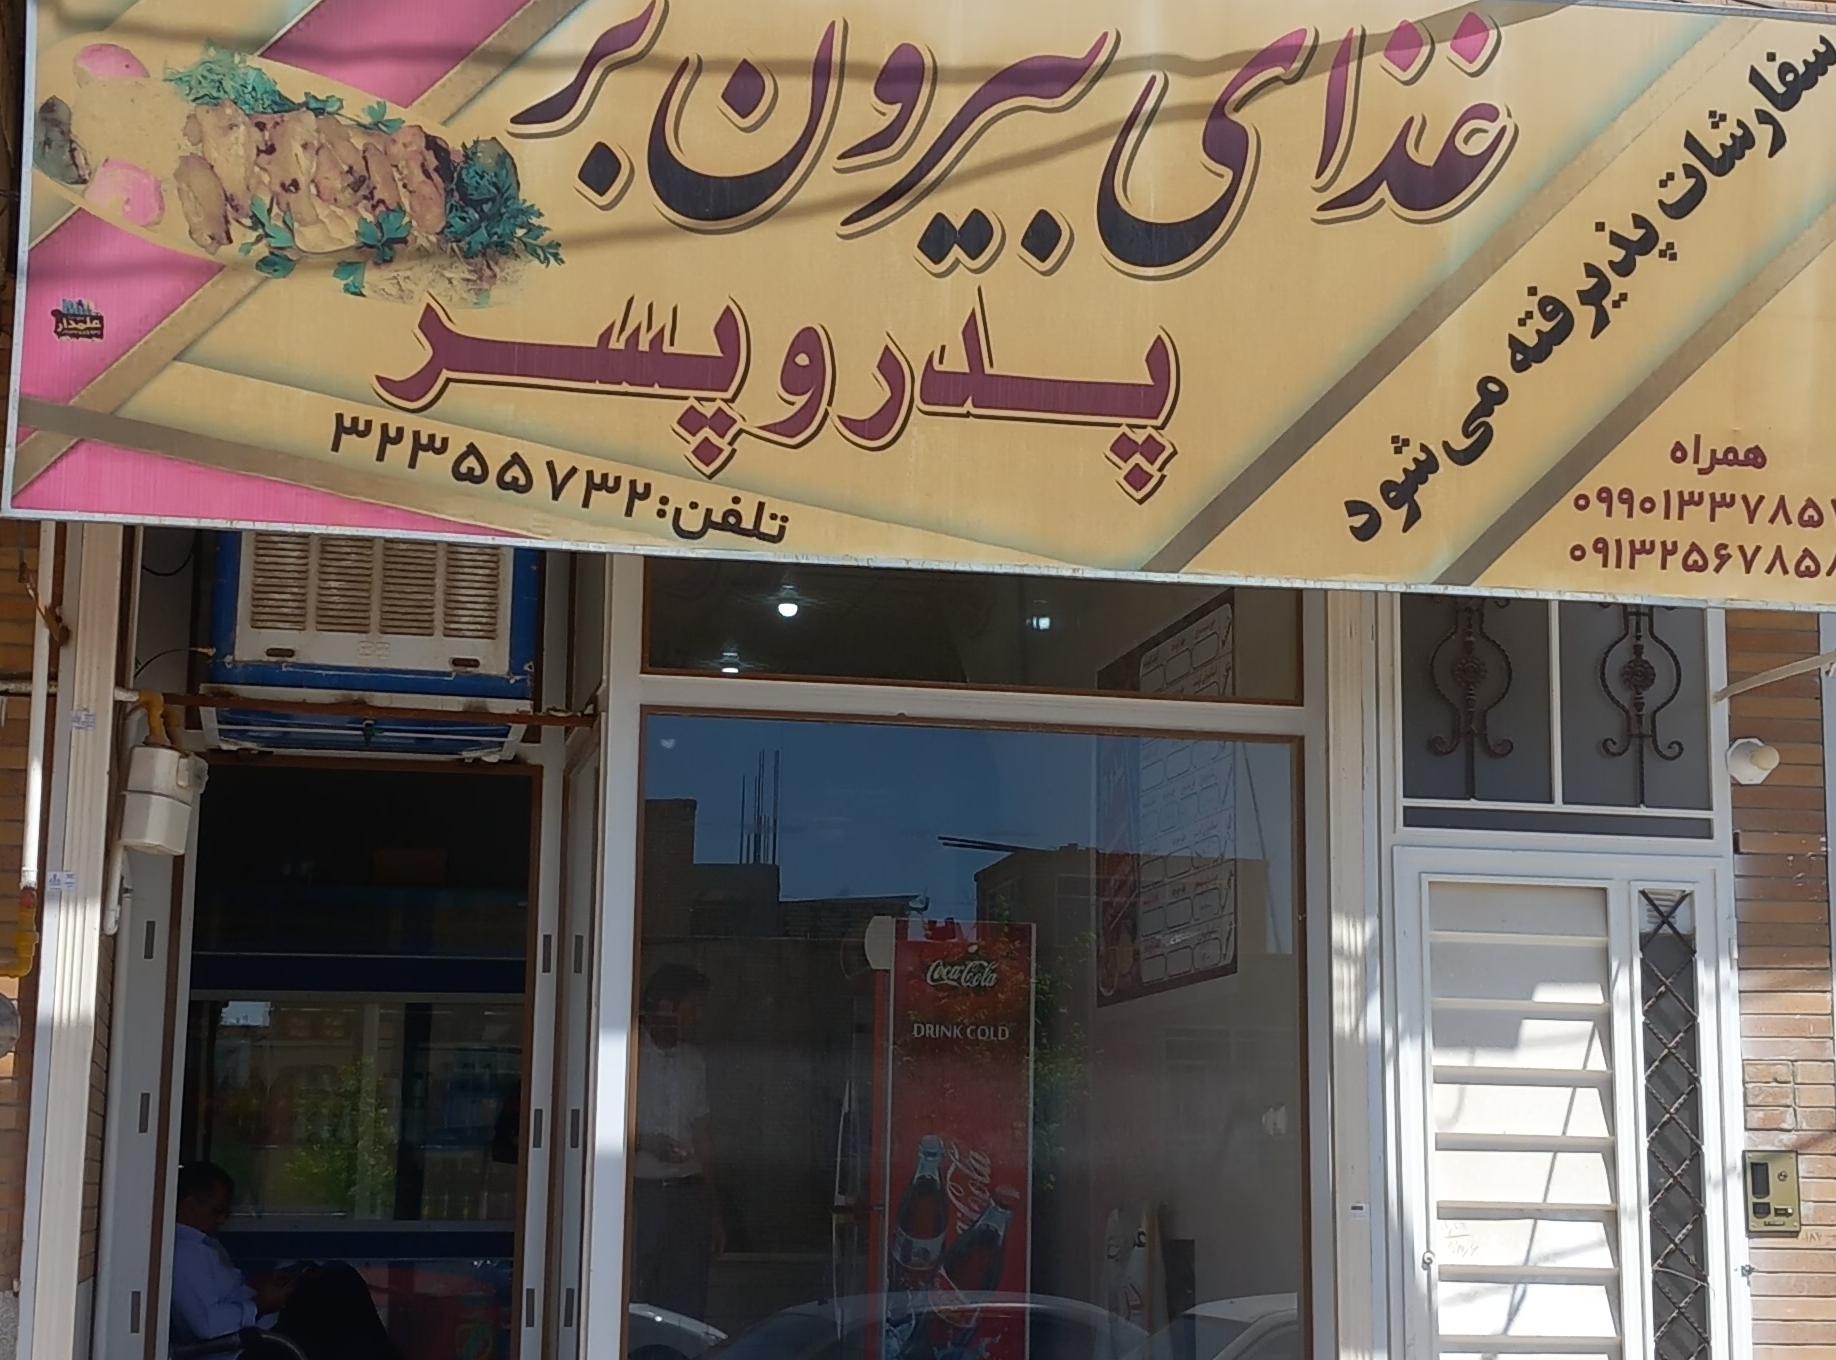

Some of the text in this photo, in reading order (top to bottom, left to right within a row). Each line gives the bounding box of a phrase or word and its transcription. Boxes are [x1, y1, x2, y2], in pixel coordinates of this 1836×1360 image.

[648, 17, 1120, 276] بیرون
[1096, 9, 1516, 278] غذای
[1658, 34, 1836, 220] سفارشات
[1507, 212, 1678, 374] پذیرفته
[372, 292, 752, 479] پسر
[1669, 433, 1768, 476] همراه
[1573, 486, 1836, 529] ۰۹۹۰۱۳۳۷۸۵
[913, 1023, 1009, 1040] DRINK COLD
